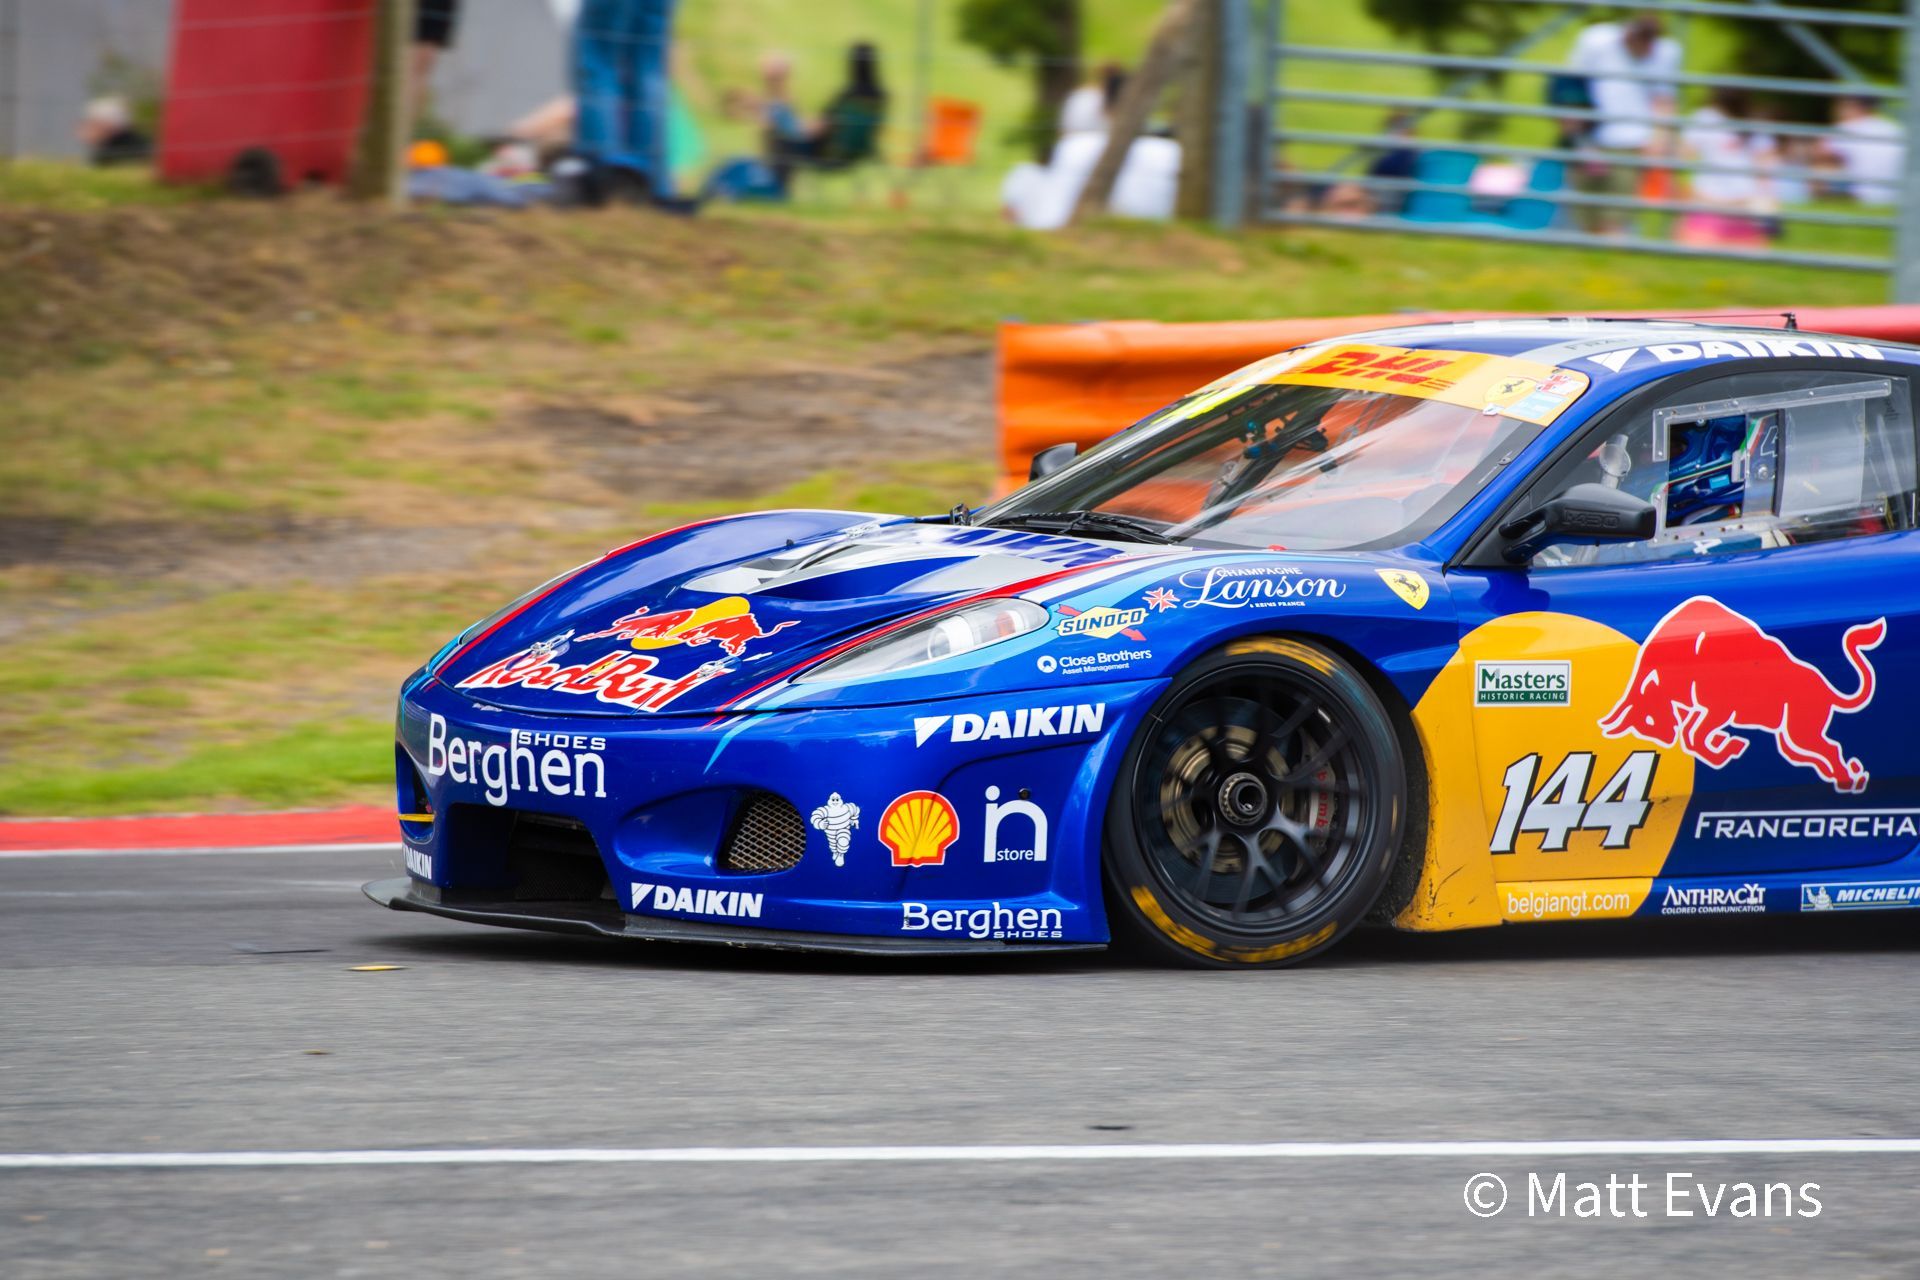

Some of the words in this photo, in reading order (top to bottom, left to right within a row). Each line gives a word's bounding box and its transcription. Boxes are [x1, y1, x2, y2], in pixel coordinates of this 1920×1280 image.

[1646, 340, 1885, 362] DAIKIN
[1300, 351, 1455, 385] DHL
[1217, 567, 1303, 577] CHAMPAGNE
[1179, 566, 1347, 609] Lanson
[1062, 610, 1143, 634] SUNOCO
[1059, 655, 1095, 668] Close
[1097, 649, 1153, 664] Brothers
[1062, 667, 1082, 675] Asset
[1084, 662, 1130, 673] Management
[1481, 668, 1566, 689] Masters
[1480, 692, 1525, 701] HISTORIC
[1529, 692, 1565, 701] RACING
[950, 703, 1106, 743] DAIKIN
[518, 732, 607, 751] SHOES
[428, 712, 607, 807] Berghen
[1489, 750, 1661, 854] 144
[983, 785, 1048, 863] in
[996, 848, 1035, 862] store
[653, 885, 764, 918] DAIKIN
[1507, 886, 1631, 918] belgiangt.com
[1661, 907, 1696, 915] COLORED
[1698, 905, 1766, 914] COMMUNICATION
[901, 902, 1063, 938] Berghen
[994, 930, 1063, 938] SHOES
